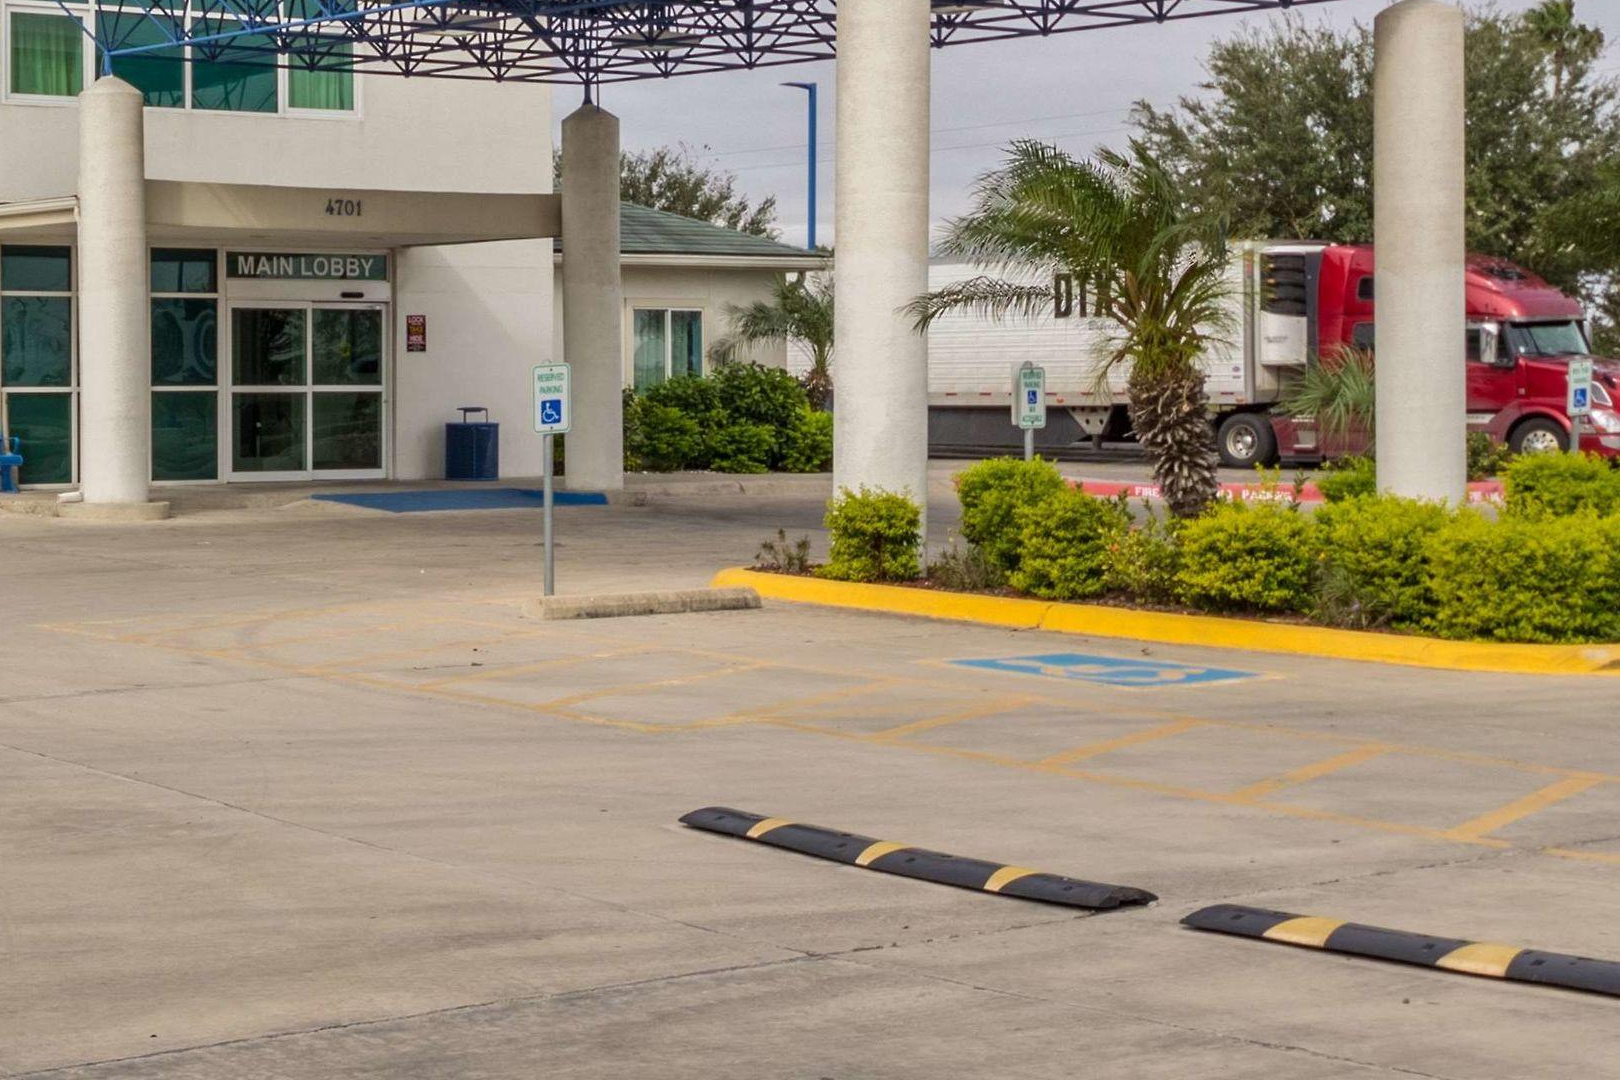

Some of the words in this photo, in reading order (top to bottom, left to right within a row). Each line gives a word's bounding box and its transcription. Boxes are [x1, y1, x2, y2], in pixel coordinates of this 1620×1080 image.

[325, 199, 362, 216] 4701
[237, 255, 294, 275] MAIN
[300, 257, 374, 277] LOBBY
[539, 384, 563, 393] PARKING
[1134, 486, 1160, 498] FIRE
